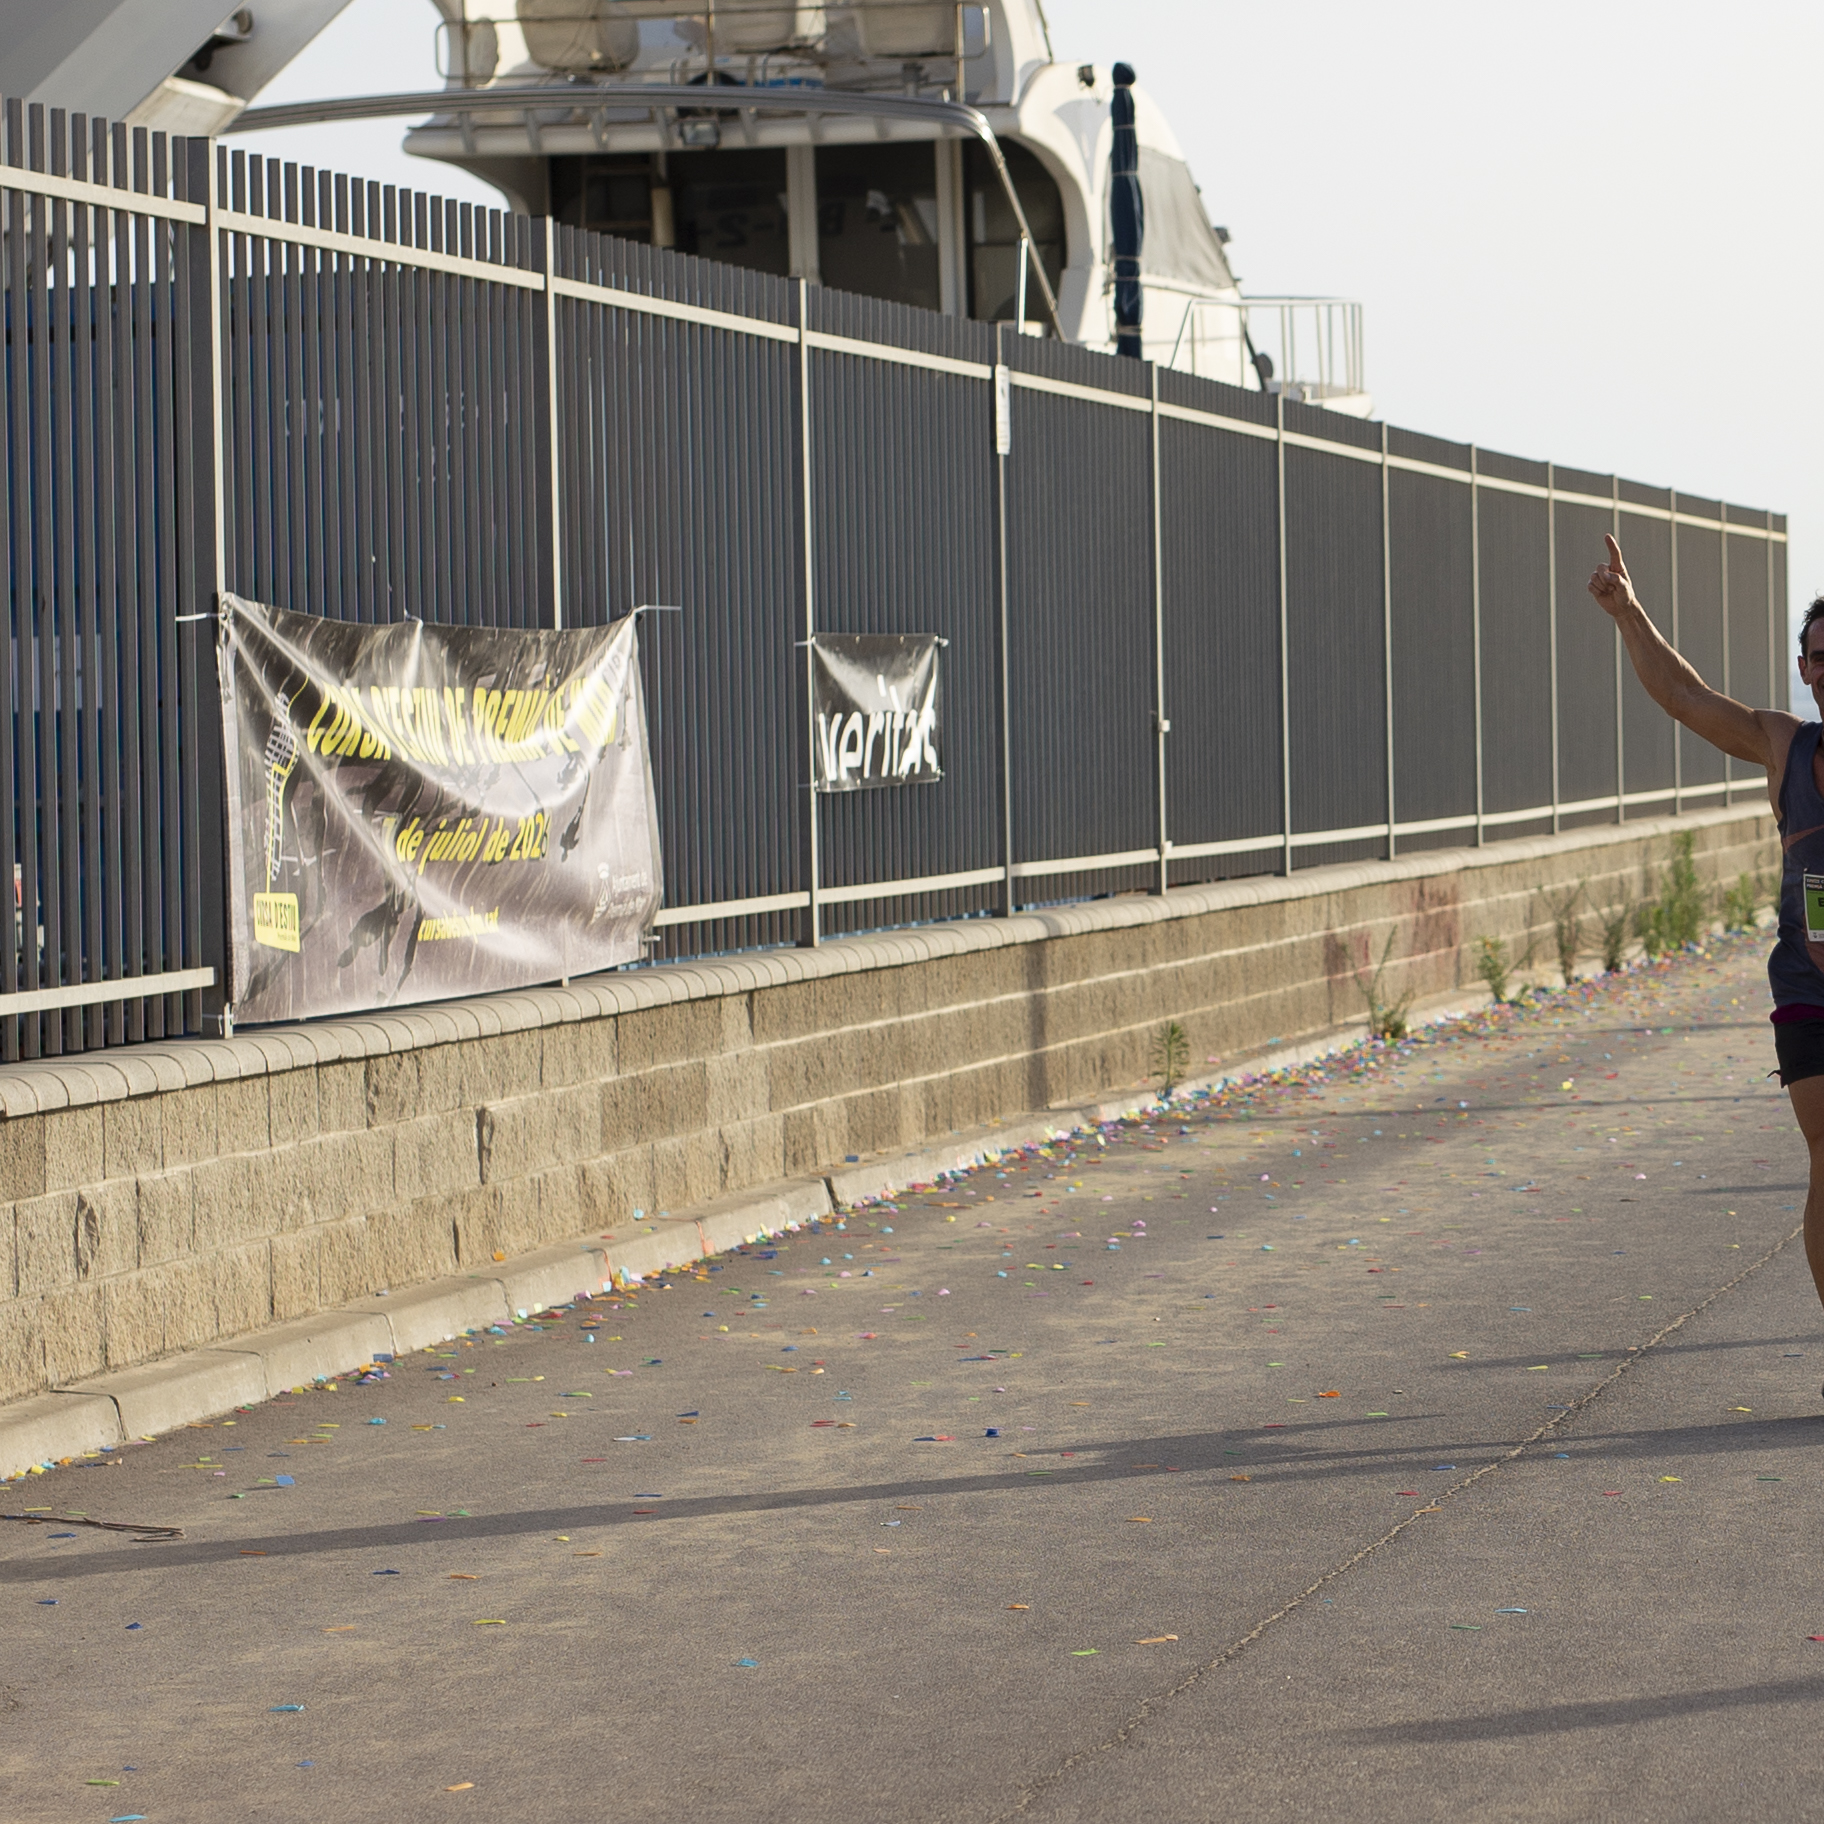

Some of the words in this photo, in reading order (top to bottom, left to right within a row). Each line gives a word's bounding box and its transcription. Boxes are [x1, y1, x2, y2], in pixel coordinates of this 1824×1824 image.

[442, 687, 474, 765] DE
[818, 674, 938, 781] veritas
[396, 817, 425, 863] de
[417, 818, 489, 876] juliol
[481, 817, 509, 862] de
